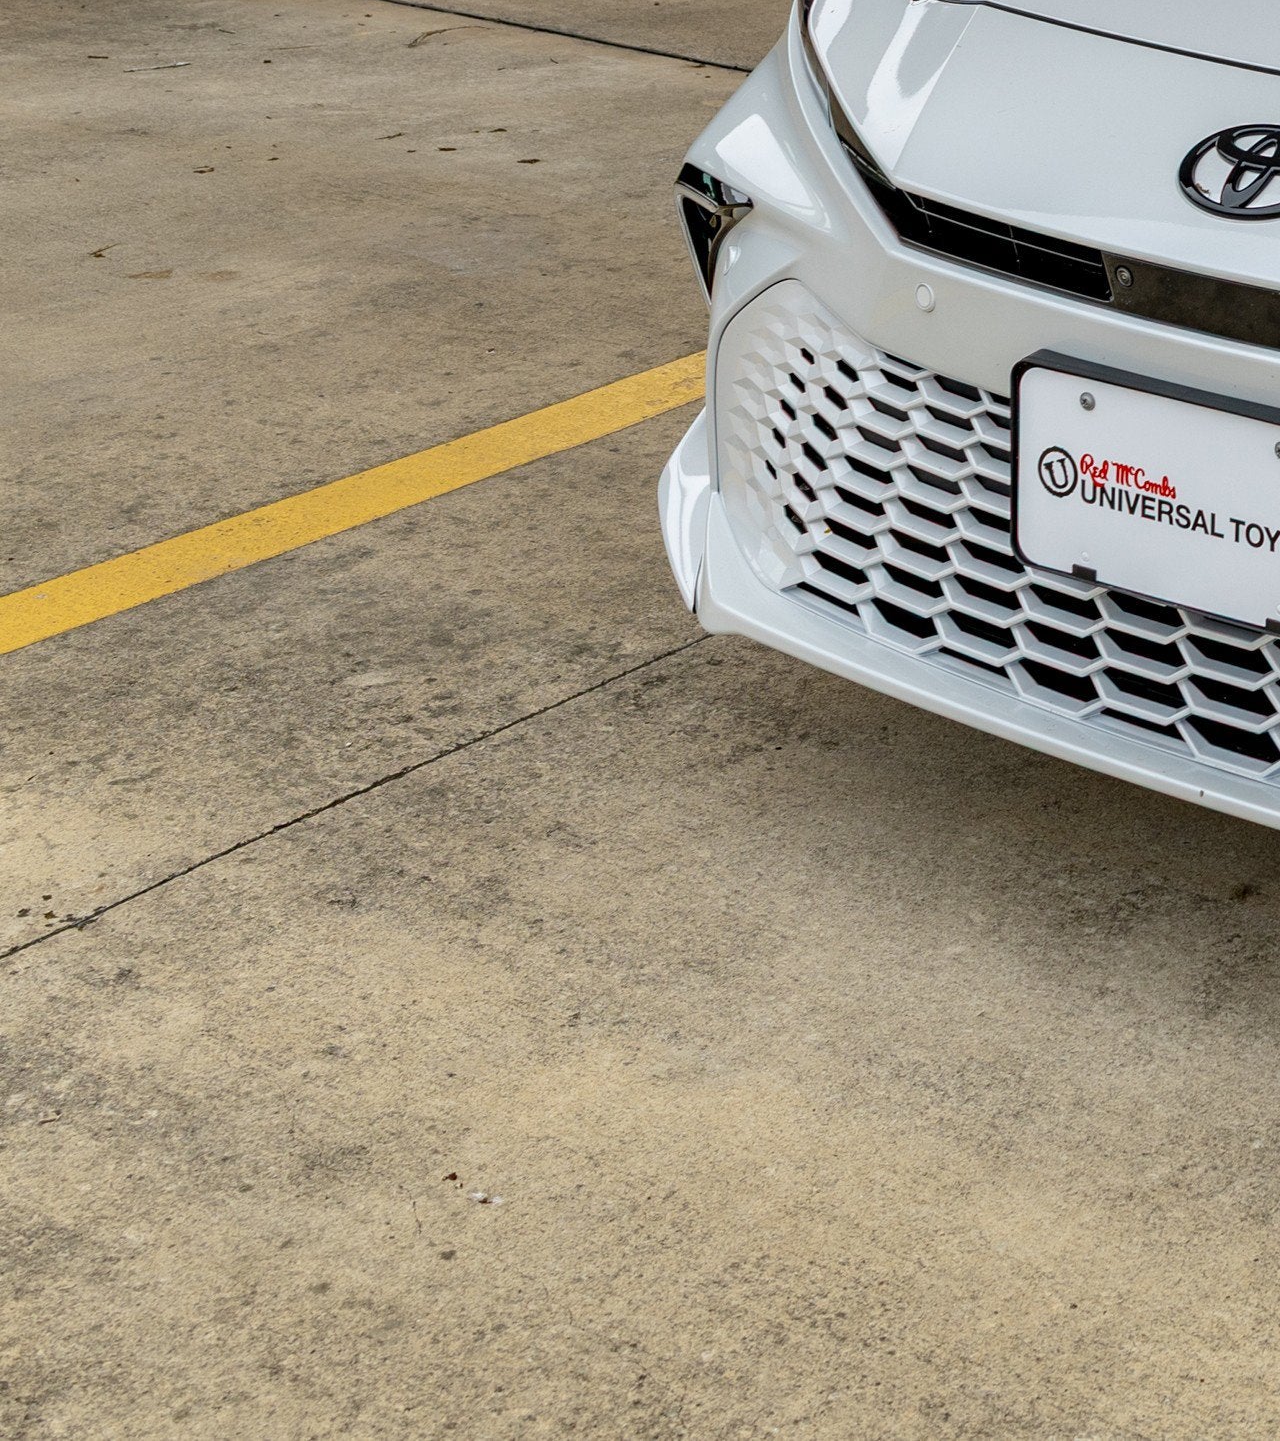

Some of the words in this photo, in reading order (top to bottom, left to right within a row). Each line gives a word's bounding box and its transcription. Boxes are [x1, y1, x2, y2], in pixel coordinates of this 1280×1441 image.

[1080, 454, 1110, 488] Red
[1112, 462, 1177, 500] McCombs
[1081, 480, 1224, 539] UNIVERSAL
